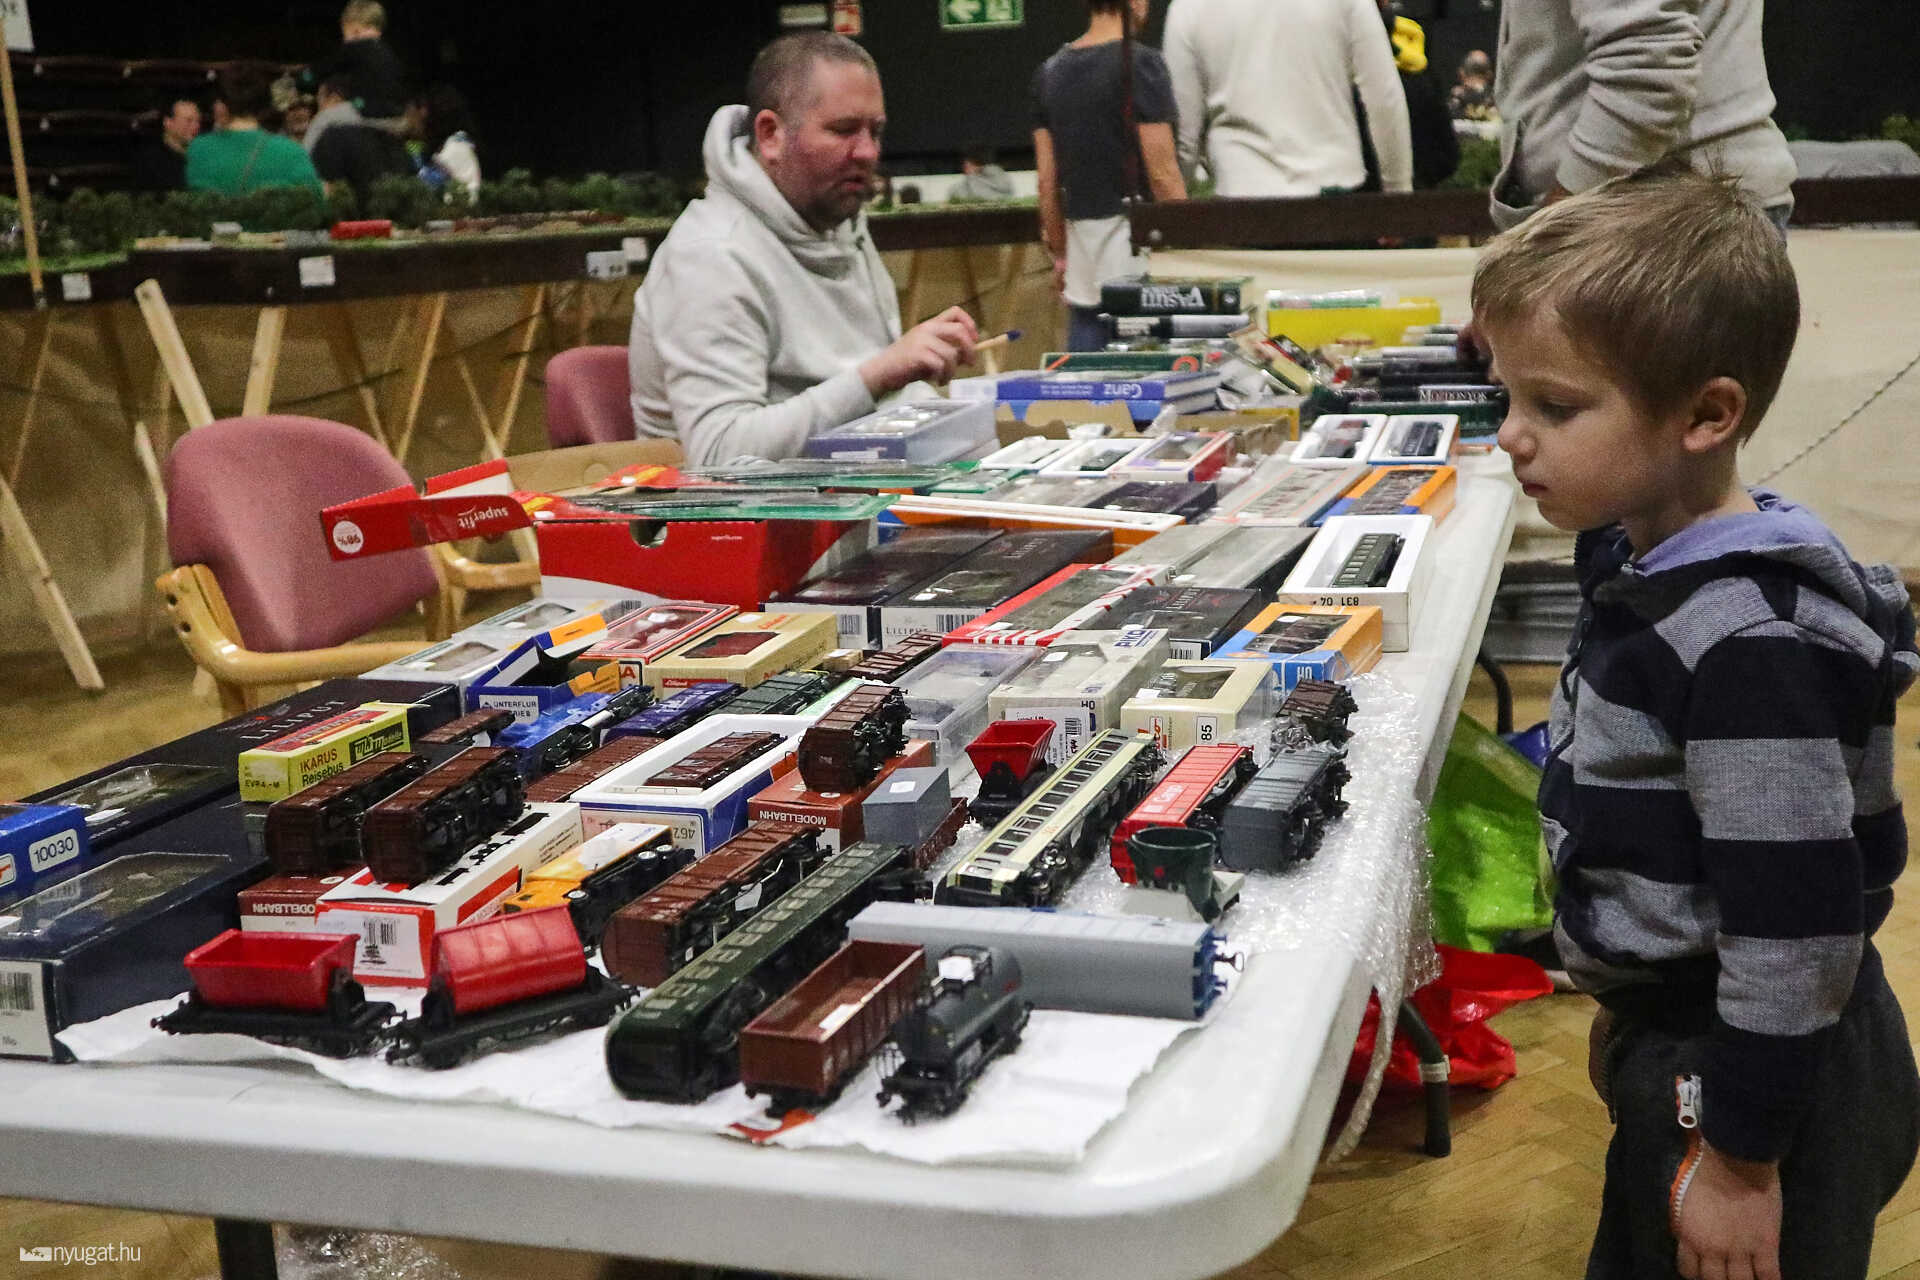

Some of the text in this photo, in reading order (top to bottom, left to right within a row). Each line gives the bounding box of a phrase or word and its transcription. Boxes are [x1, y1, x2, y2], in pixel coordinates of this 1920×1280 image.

[1104, 383, 1143, 398] Ganz
[457, 507, 508, 529] superfit
[1341, 596, 1359, 606] 831
[1114, 629, 1145, 648] PIKO
[240, 701, 345, 740] LILIPUT
[1201, 724, 1213, 741] 85
[300, 748, 338, 774] IKARUS
[302, 762, 344, 787] Reisebus
[759, 809, 827, 825] MODELLBAHN
[33, 836, 74, 864] 10030
[252, 903, 316, 914] ODELLBAHN
